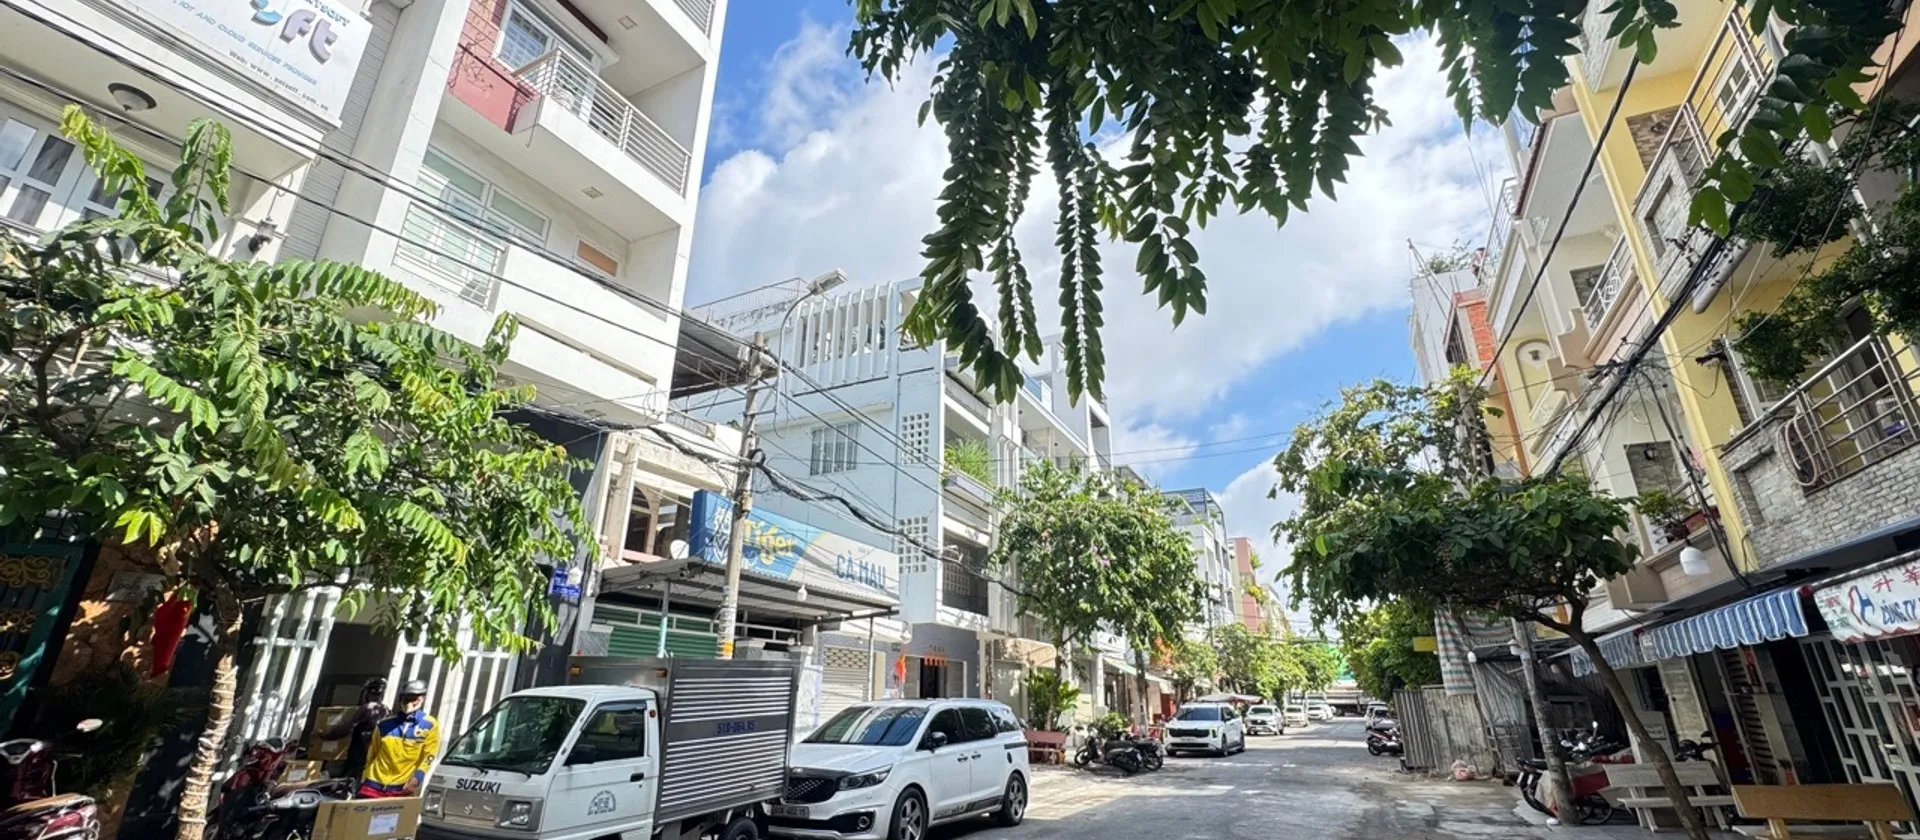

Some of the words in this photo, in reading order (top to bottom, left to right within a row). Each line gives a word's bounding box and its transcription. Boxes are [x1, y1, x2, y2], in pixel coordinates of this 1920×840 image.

[196, 12, 216, 26] AND
[217, 24, 246, 44] CLOUD
[743, 519, 796, 565] Tiger
[1902, 598, 1917, 621] TY
[456, 778, 502, 795] SUZUKI
